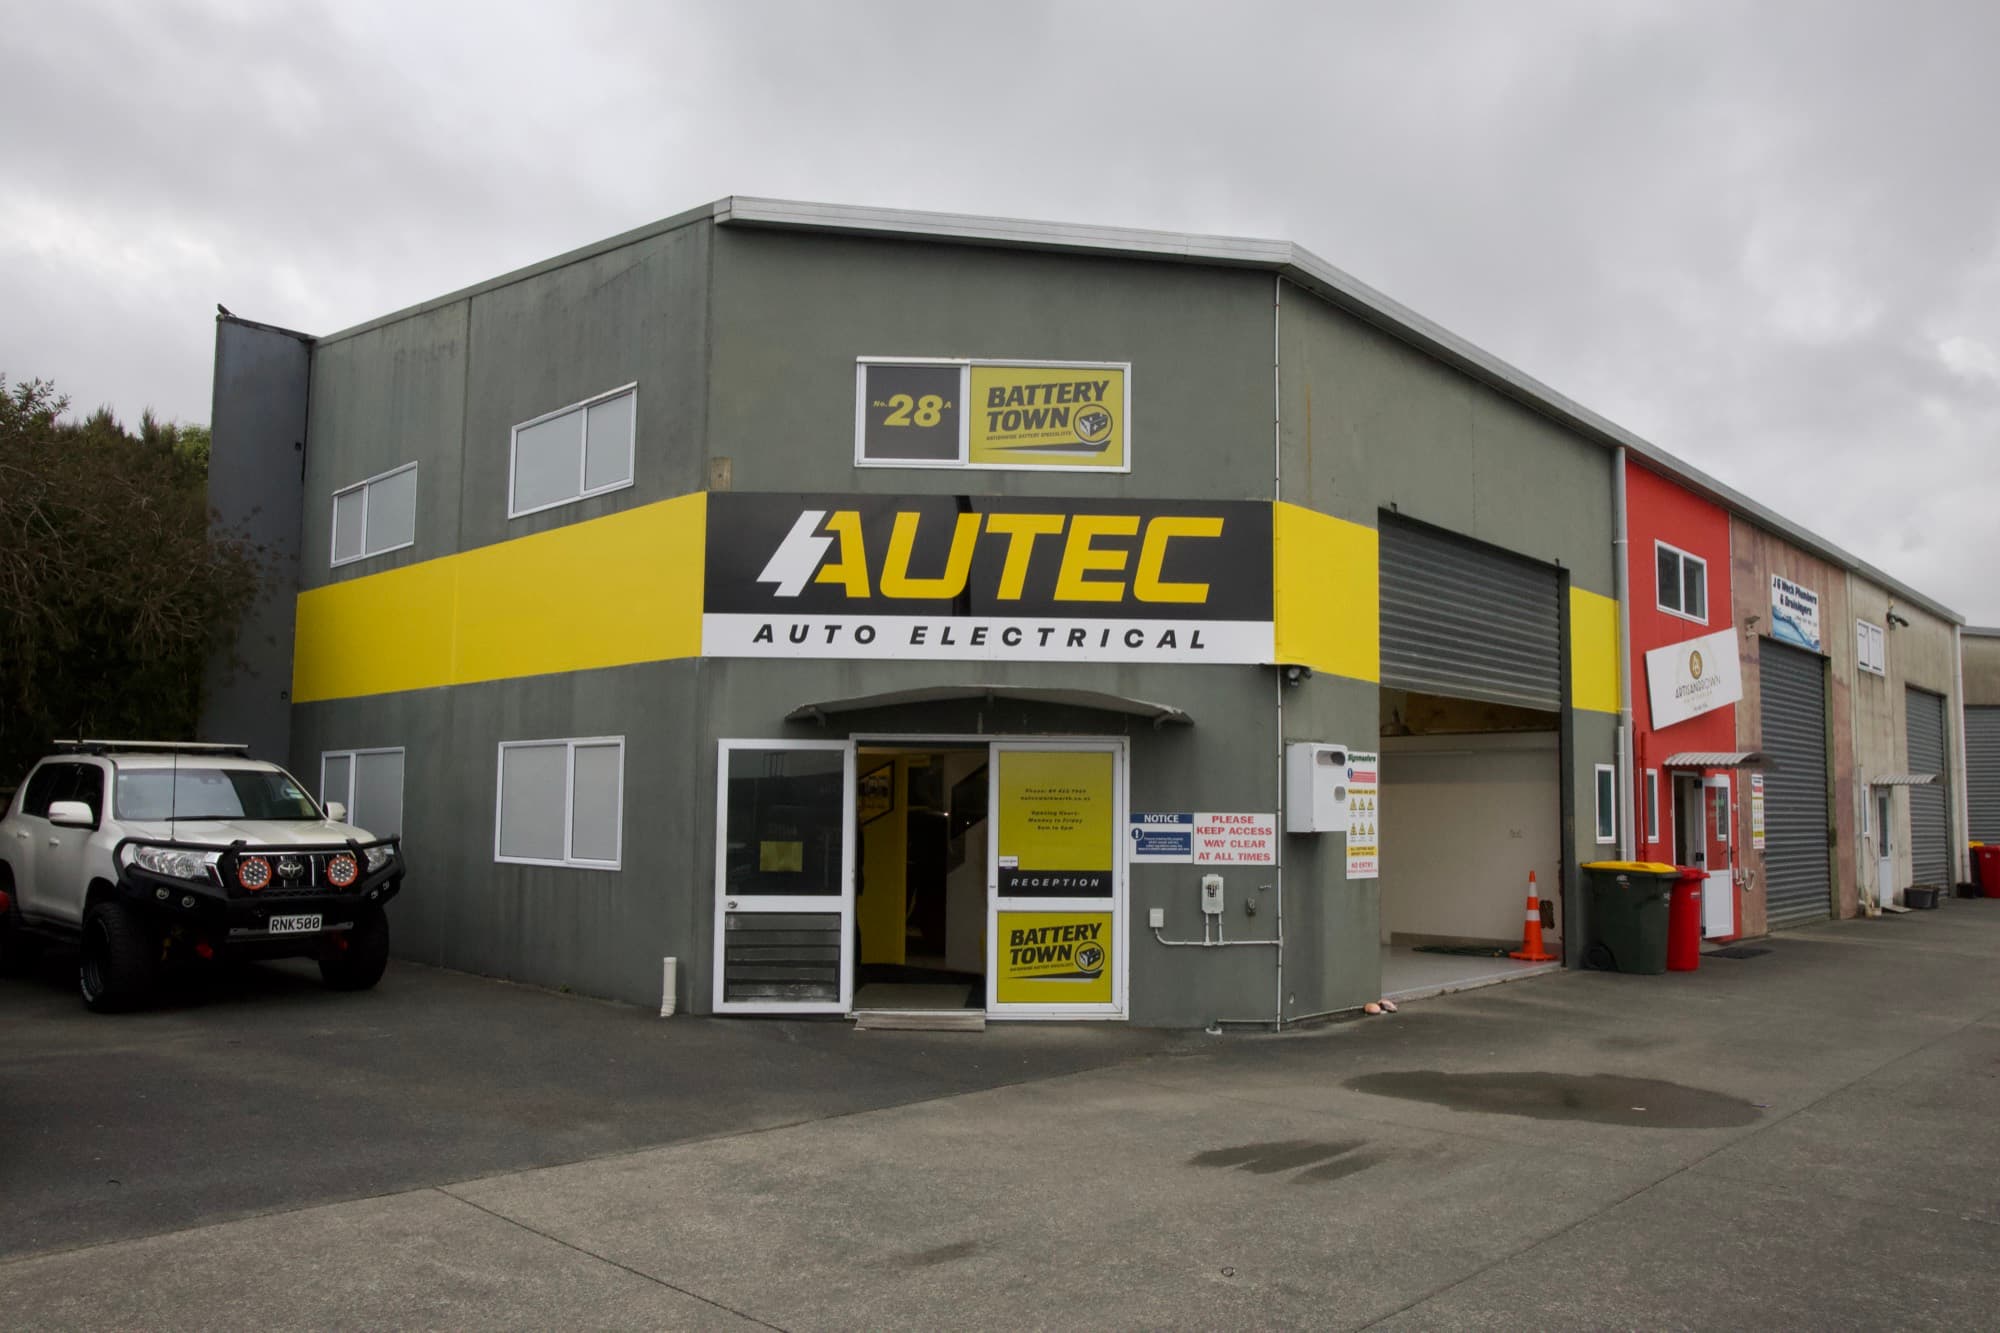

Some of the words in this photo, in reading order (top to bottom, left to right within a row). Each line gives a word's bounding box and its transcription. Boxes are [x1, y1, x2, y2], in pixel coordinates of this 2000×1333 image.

[986, 380, 1110, 409] BATTERY
[883, 394, 943, 427] 28
[986, 407, 1070, 433] TOWN
[812, 510, 1225, 604] AUTEC
[752, 623, 877, 645] AUTO
[909, 625, 1206, 650] ELECTRICAL
[1144, 814, 1179, 824] NOTICE
[1211, 815, 1254, 824] PLEASE
[1196, 826, 1225, 836] KEEP
[1229, 827, 1272, 836] ACCESS
[1203, 839, 1226, 848] WAY
[1230, 840, 1266, 849] CLEAR
[1198, 852, 1210, 861] AT
[1214, 853, 1234, 861] ALL
[1238, 853, 1271, 862] TIMES
[1010, 878, 1100, 887] RECEPTION
[271, 917, 320, 931] RNK500
[1010, 922, 1102, 947] BATTERY
[1010, 944, 1073, 966] TOWN
